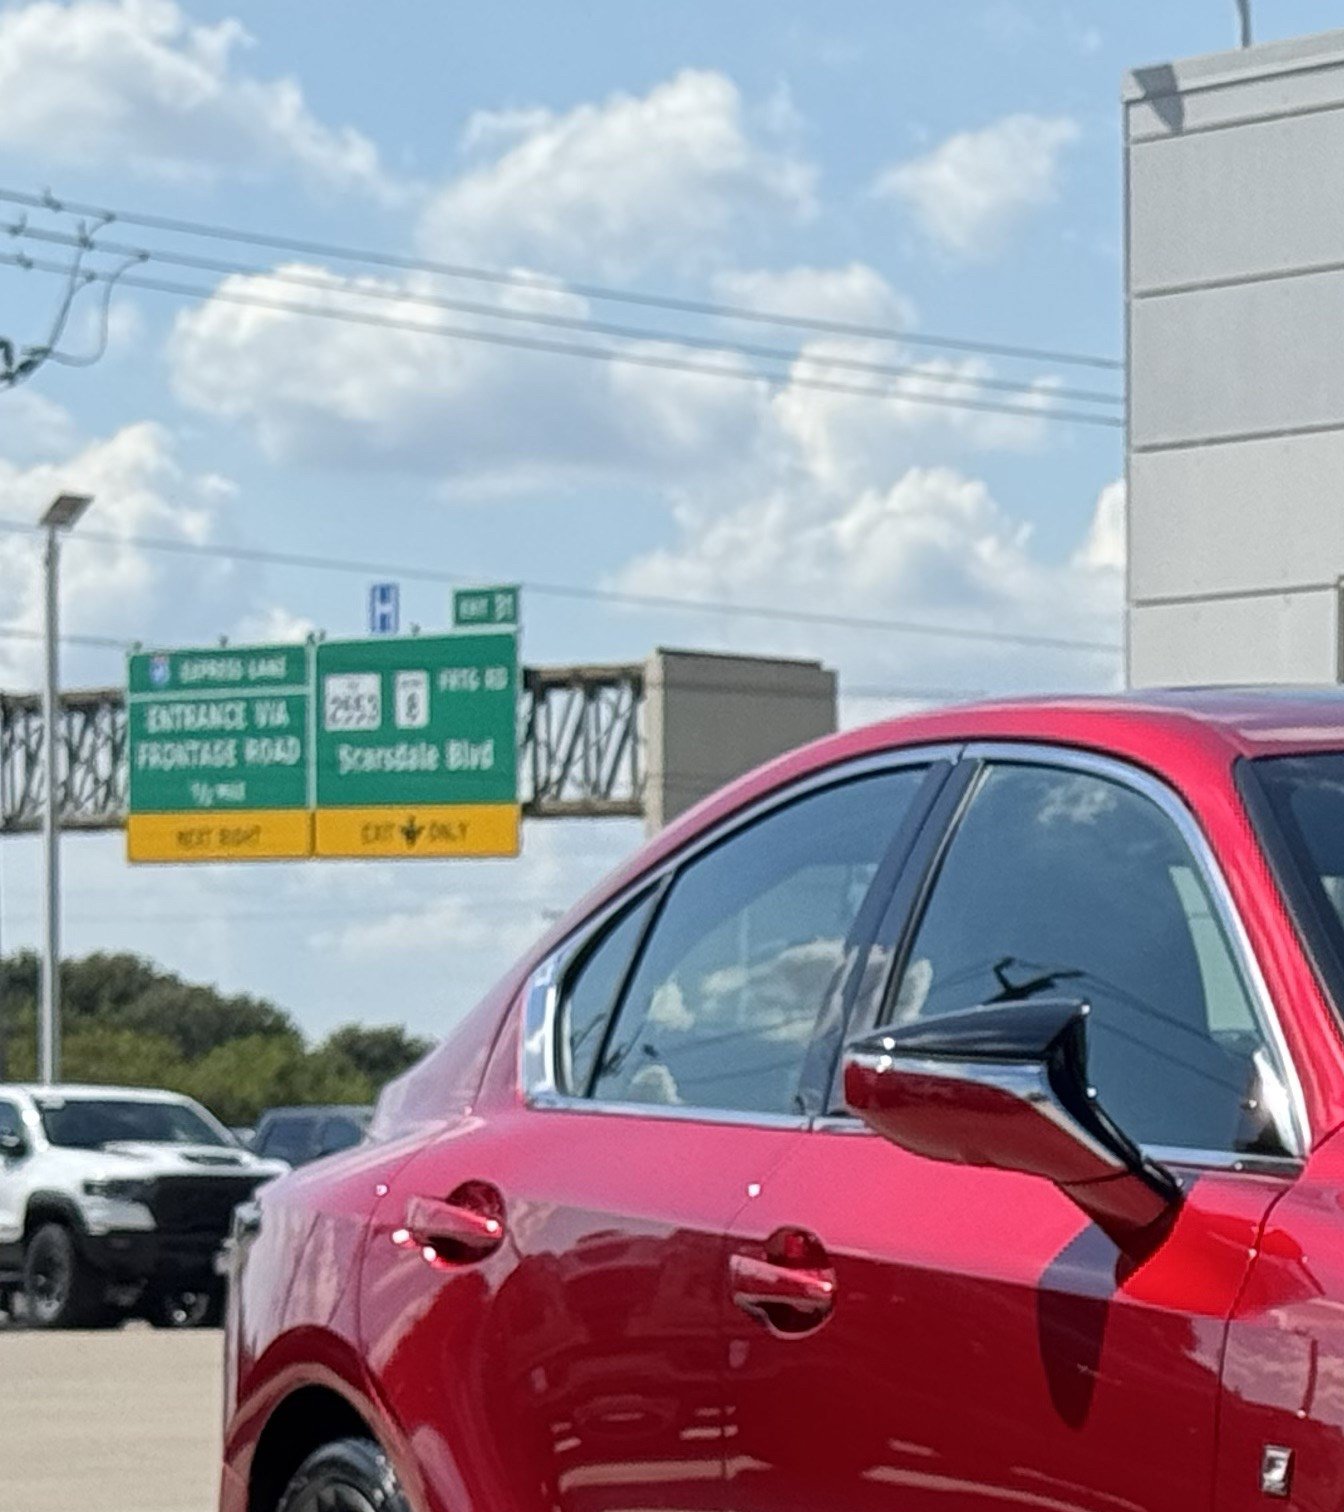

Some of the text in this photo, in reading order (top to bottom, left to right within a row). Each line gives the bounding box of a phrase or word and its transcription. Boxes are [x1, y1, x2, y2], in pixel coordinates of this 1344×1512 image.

[147, 700, 290, 734] ENTRANCE VIA
[137, 736, 302, 772] FRONTAGE ROAD
[338, 738, 495, 776] Scarsdale Blvd
